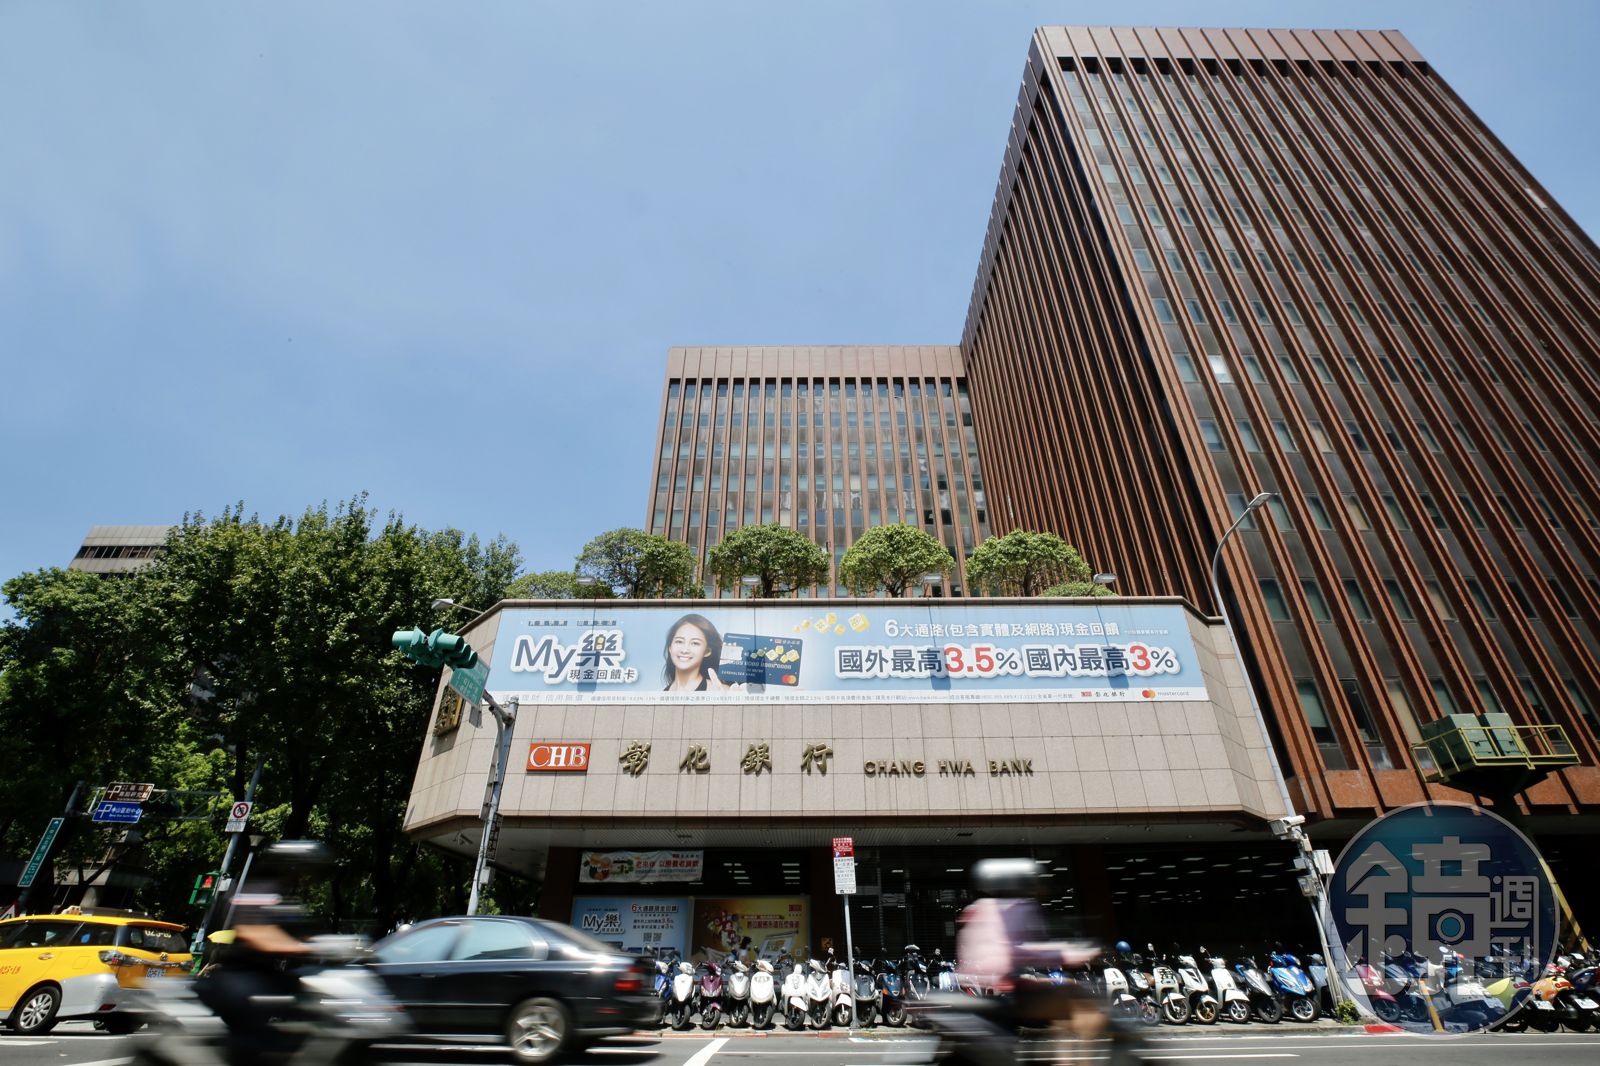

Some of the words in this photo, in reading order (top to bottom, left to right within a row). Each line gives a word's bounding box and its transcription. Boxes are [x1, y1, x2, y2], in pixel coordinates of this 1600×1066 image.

[884, 619, 1120, 637] 6大通路(包含實體及網路)現金回饋
[838, 646, 1018, 673] 國外最高3.5%
[1025, 645, 1174, 672] 國內最高3%
[569, 668, 635, 680] 現金回饋卡
[528, 743, 588, 769] CHB
[619, 739, 834, 776] 彰化銀行
[864, 758, 925, 778] CHANG
[937, 758, 975, 778] HWA
[989, 758, 1034, 777] BANK
